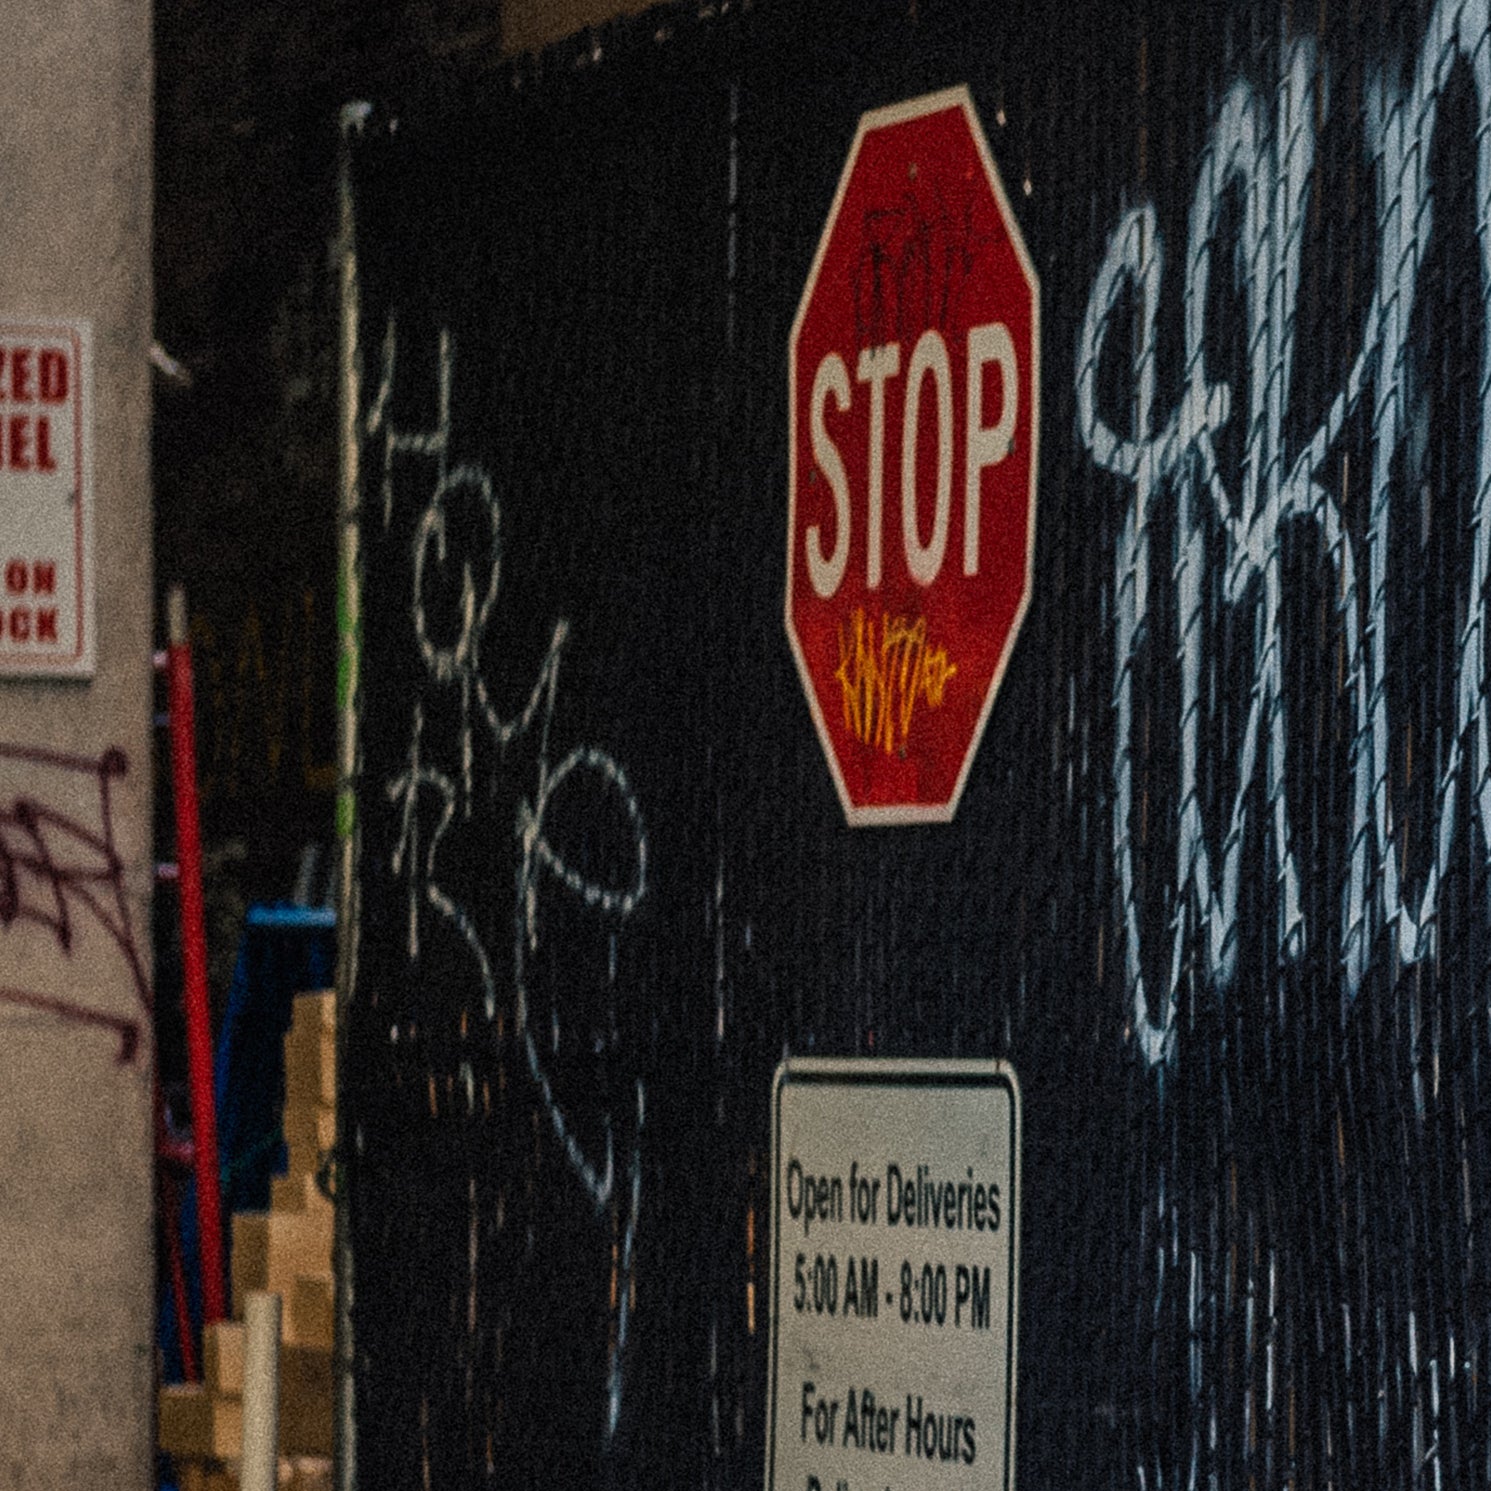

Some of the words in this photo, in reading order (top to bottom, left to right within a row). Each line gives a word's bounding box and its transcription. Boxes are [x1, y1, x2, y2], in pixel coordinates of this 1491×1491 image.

[0, 348, 69, 403] ED
[0, 414, 57, 474] EL
[804, 321, 1019, 598] STOP
[4, 560, 57, 597] ON
[0, 608, 59, 644] CK
[786, 1158, 843, 1238] Open
[850, 1160, 881, 1224] for
[887, 1163, 1001, 1232] Deliveries
[794, 1252, 838, 1317] 5:00
[843, 1255, 879, 1319] AM
[900, 1259, 947, 1327] 8:00
[954, 1264, 991, 1330] PM
[801, 1380, 839, 1446] For
[842, 1387, 900, 1454] After
[905, 1393, 976, 1465] Hours
